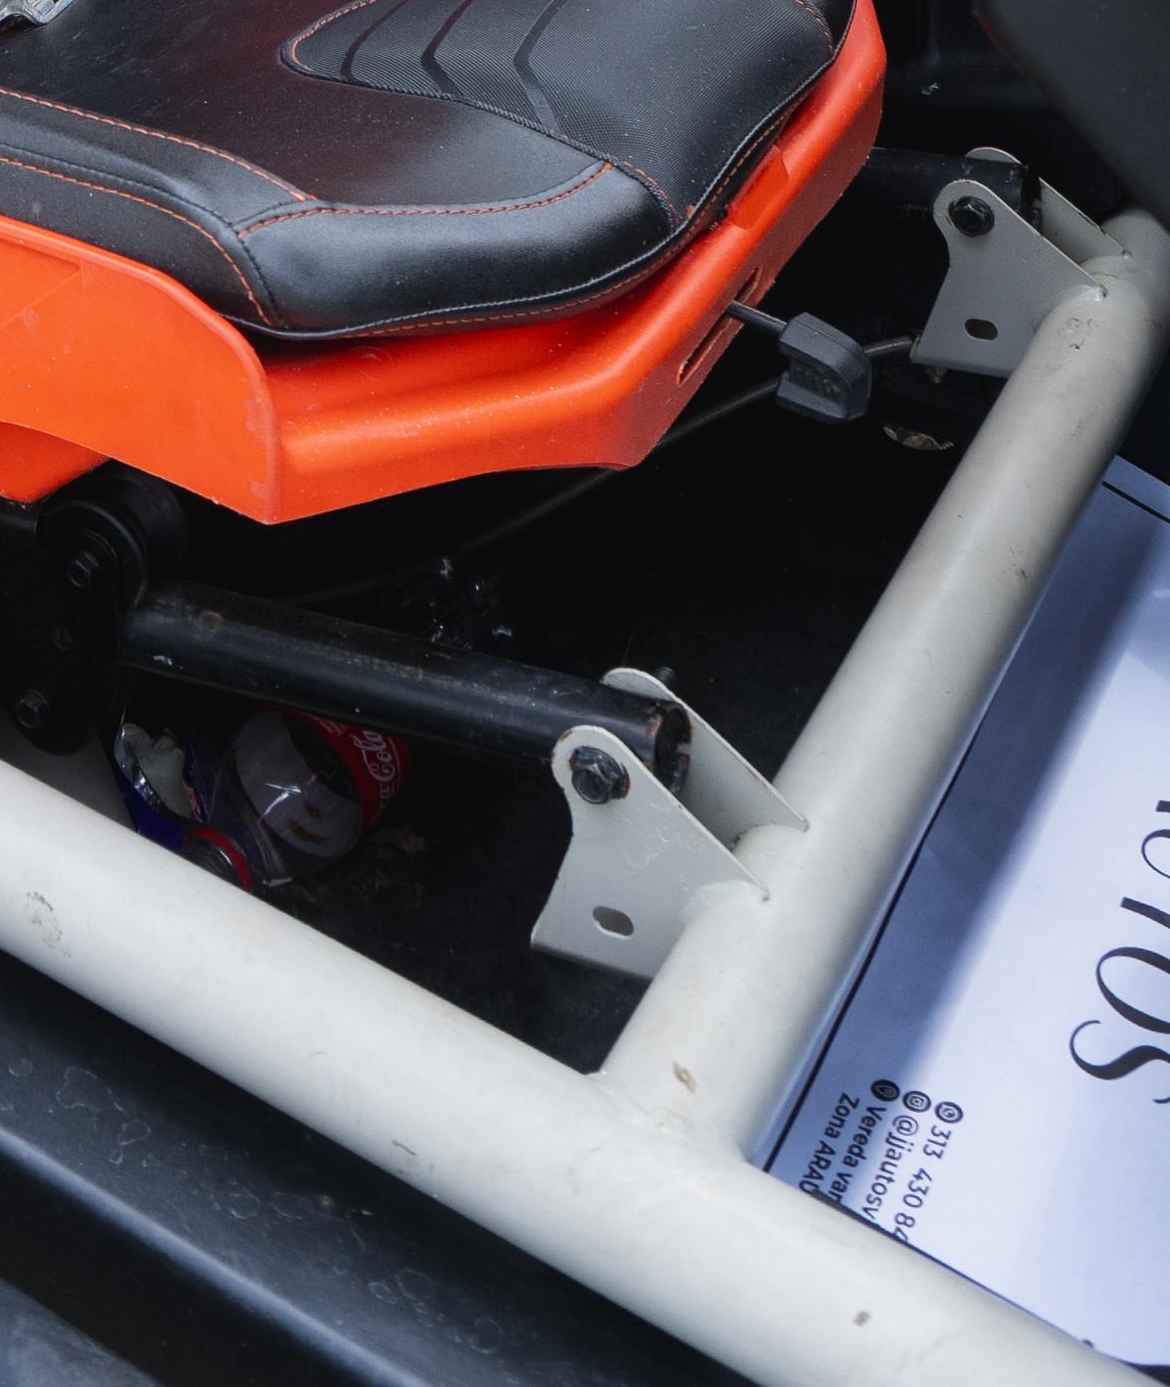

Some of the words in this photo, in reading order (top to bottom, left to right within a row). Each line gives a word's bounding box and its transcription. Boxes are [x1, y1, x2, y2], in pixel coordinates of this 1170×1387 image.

[823, 1092, 860, 1139] Zona
[842, 1105, 887, 1169] Vereda
[923, 1125, 952, 1159] 313
[902, 1168, 932, 1209] 430
